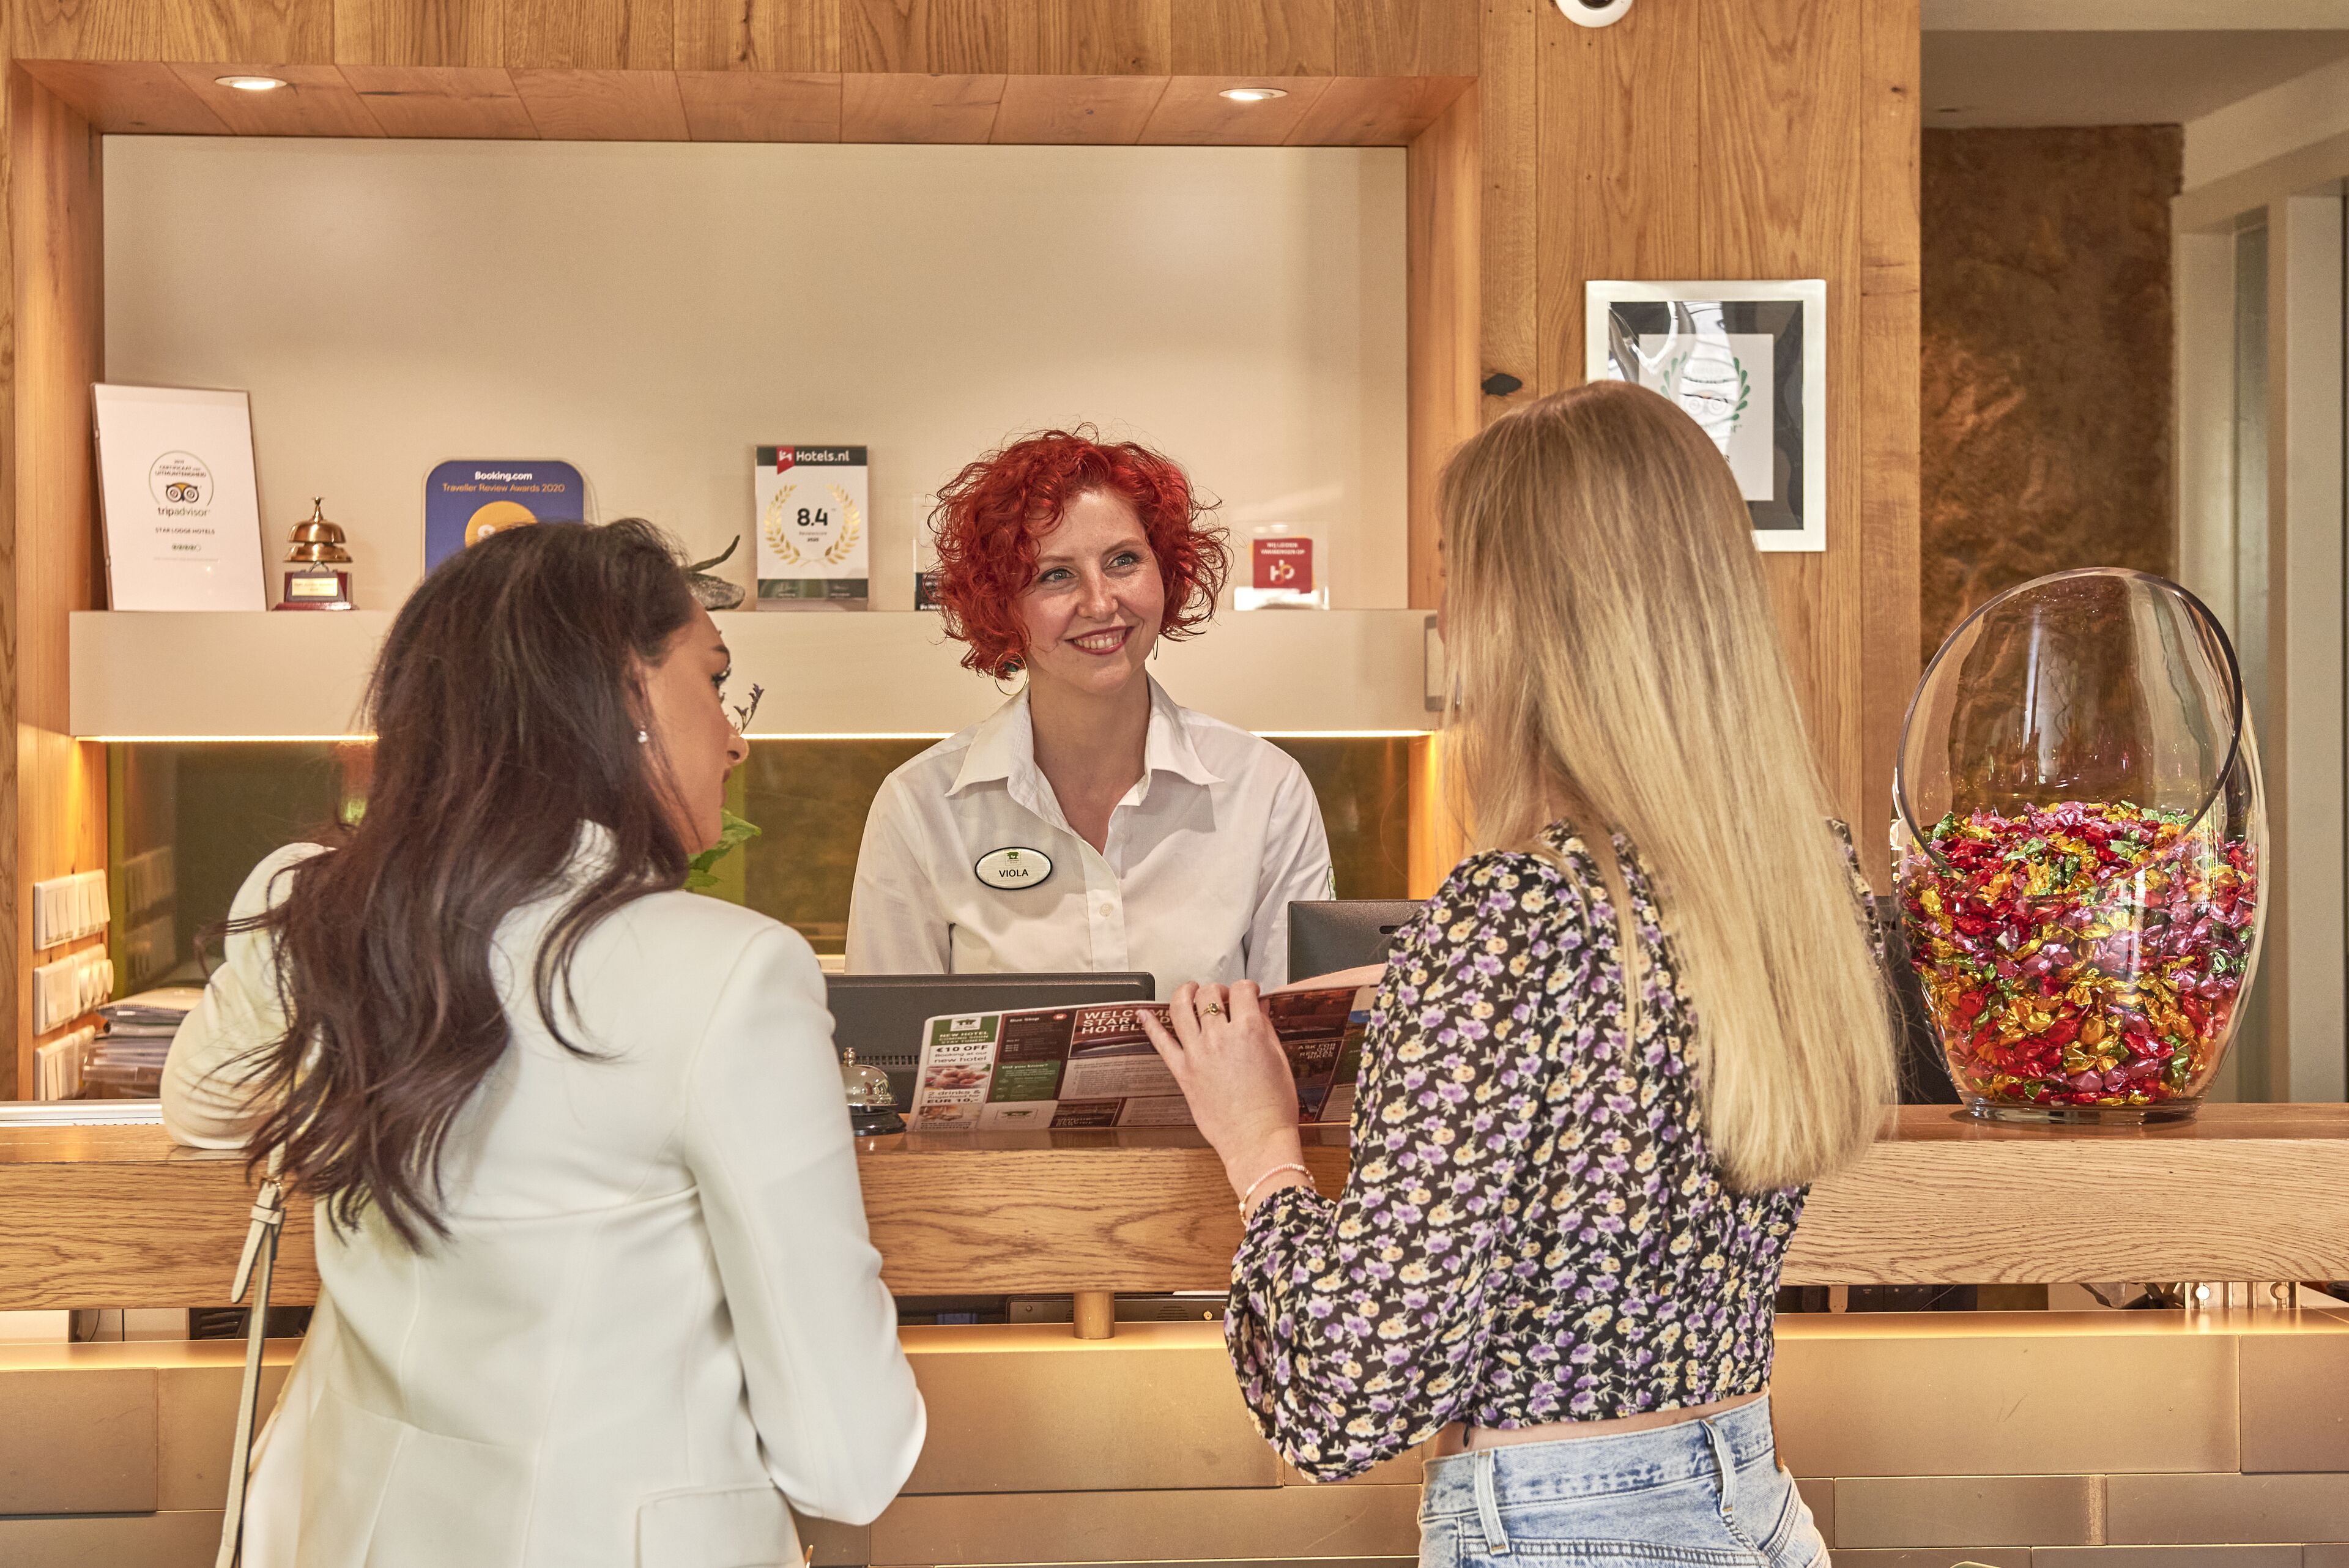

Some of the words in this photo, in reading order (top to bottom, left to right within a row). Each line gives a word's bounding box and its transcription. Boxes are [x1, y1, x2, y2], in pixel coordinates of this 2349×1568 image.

[796, 450, 850, 462] Hotels.nl
[475, 471, 533, 482] Booking.com
[442, 483, 477, 492] Traveller
[479, 483, 508, 492] Review
[510, 484, 540, 492] Awards
[542, 484, 566, 492] 2020
[158, 507, 207, 517] tripadvisor
[797, 508, 828, 527] 8.4
[999, 869, 1028, 877] VIOLA
[1083, 1017, 1130, 1027] STAR
